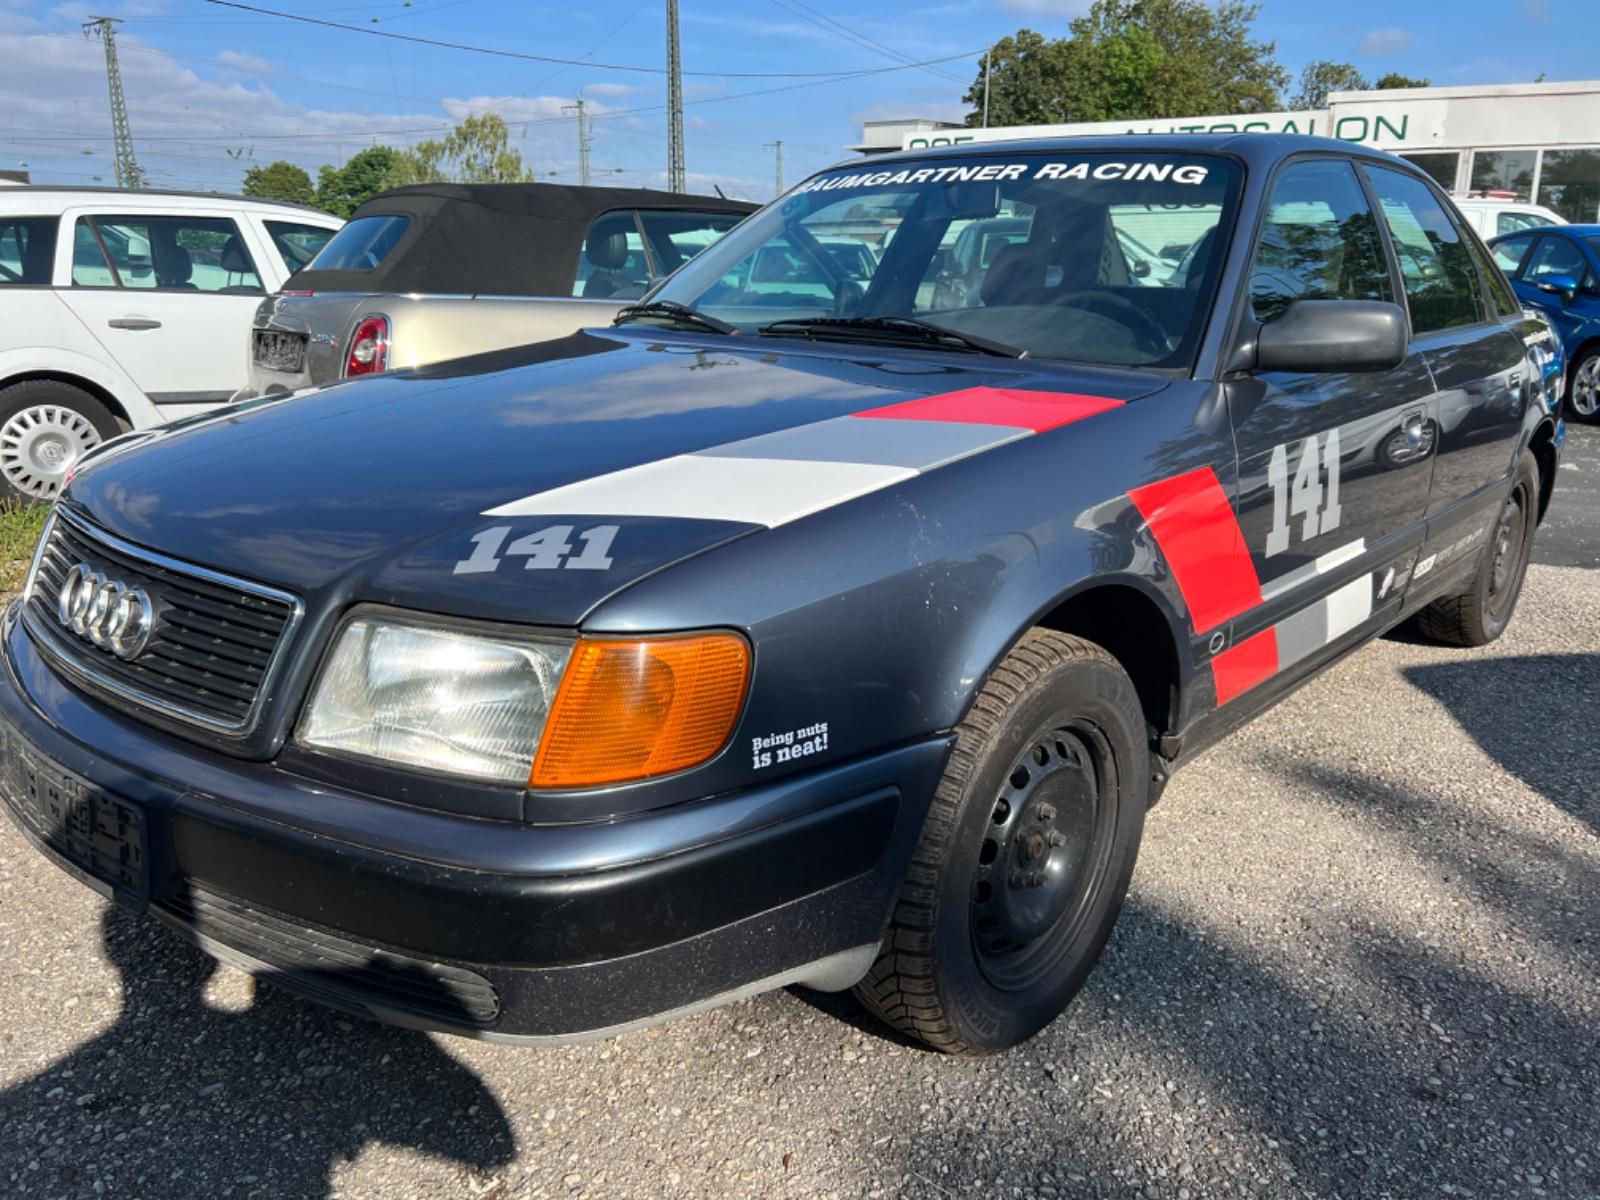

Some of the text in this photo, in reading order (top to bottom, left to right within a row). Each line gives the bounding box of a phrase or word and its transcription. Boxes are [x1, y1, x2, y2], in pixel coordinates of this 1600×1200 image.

[1126, 114, 1409, 142] SALON
[1033, 161, 1209, 185] RACING
[1265, 427, 1342, 559] 141
[452, 525, 620, 575] 141
[752, 722, 828, 751] Being nuts
[752, 733, 828, 769] is neat!
